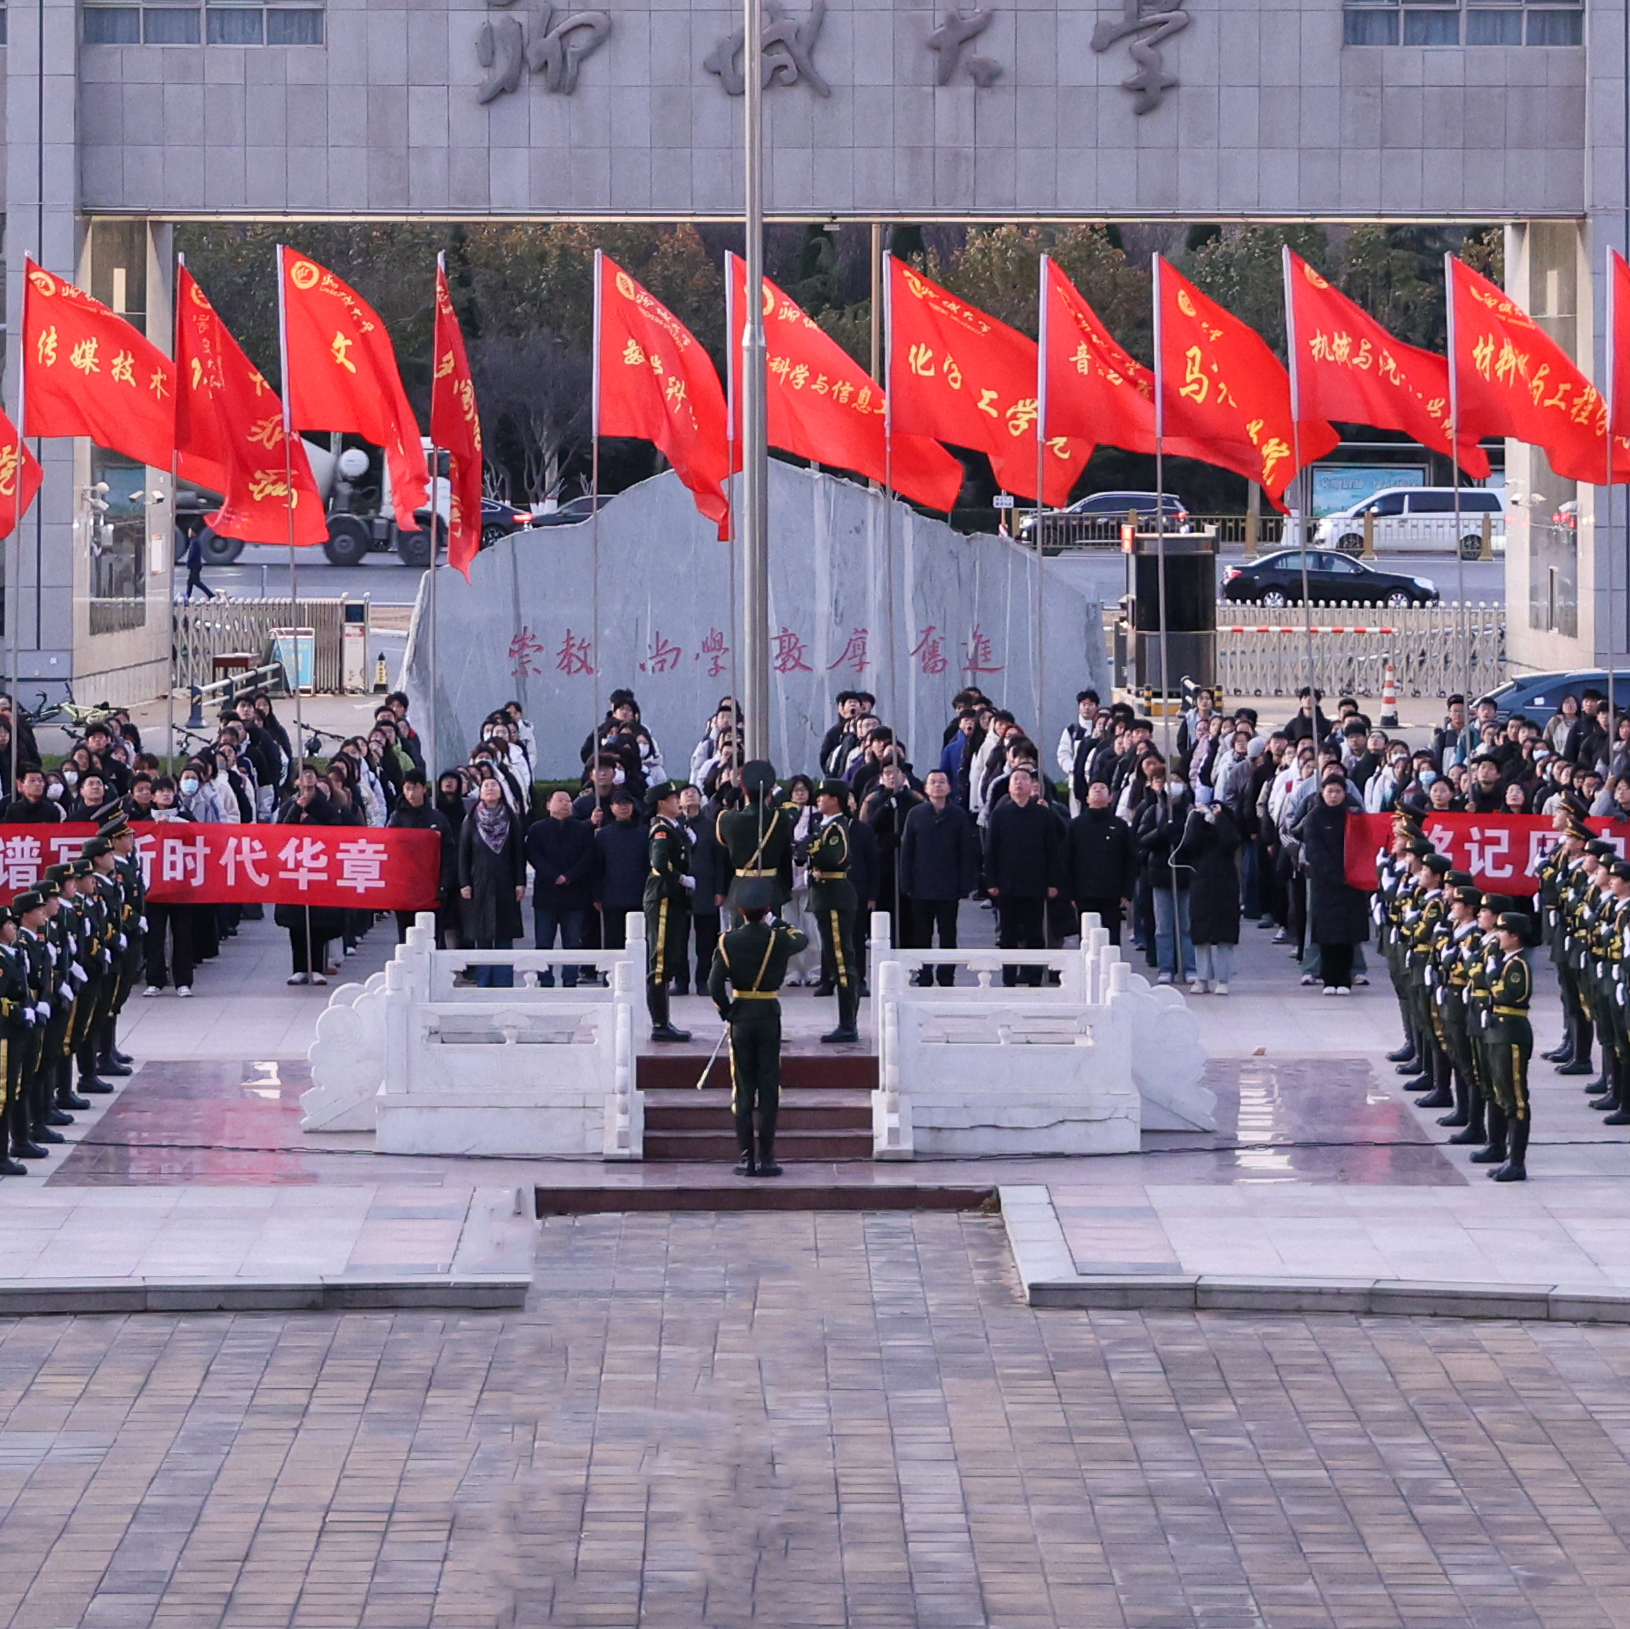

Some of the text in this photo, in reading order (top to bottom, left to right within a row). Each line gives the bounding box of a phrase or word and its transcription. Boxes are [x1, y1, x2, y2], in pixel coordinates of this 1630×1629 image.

[37, 325, 171, 400] 传媒技术
[508, 625, 595, 678] 崇教
